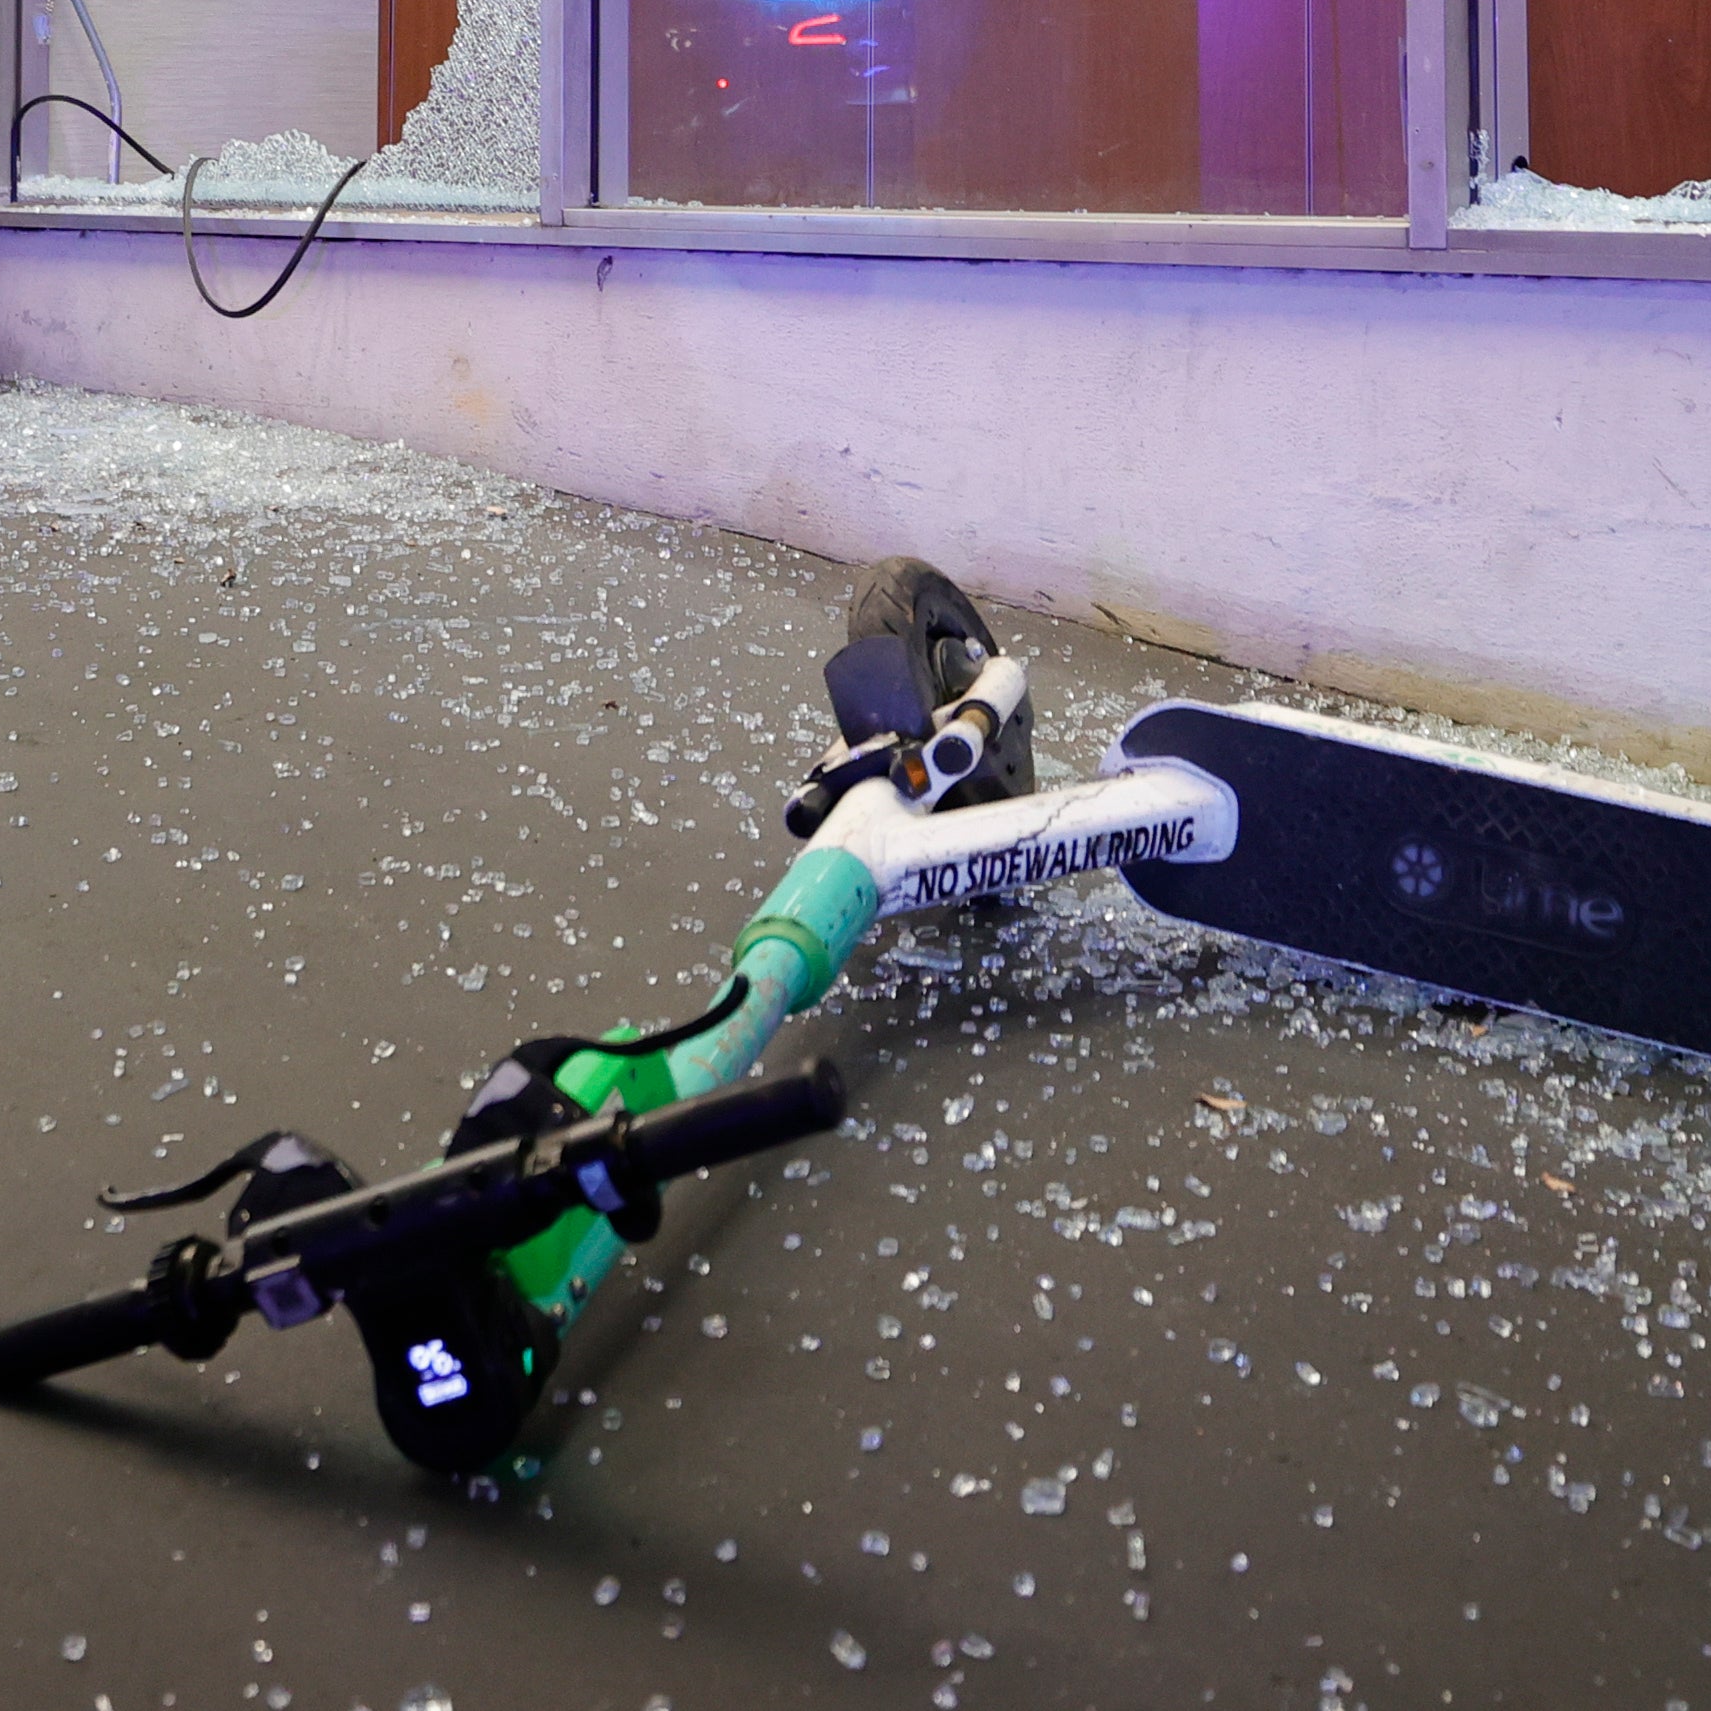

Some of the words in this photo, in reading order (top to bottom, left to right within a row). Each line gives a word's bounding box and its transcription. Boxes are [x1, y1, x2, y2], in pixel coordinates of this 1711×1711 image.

[916, 862, 959, 904] NO
[965, 833, 1105, 894] SIDEWALK
[1106, 816, 1194, 867] RIDING
